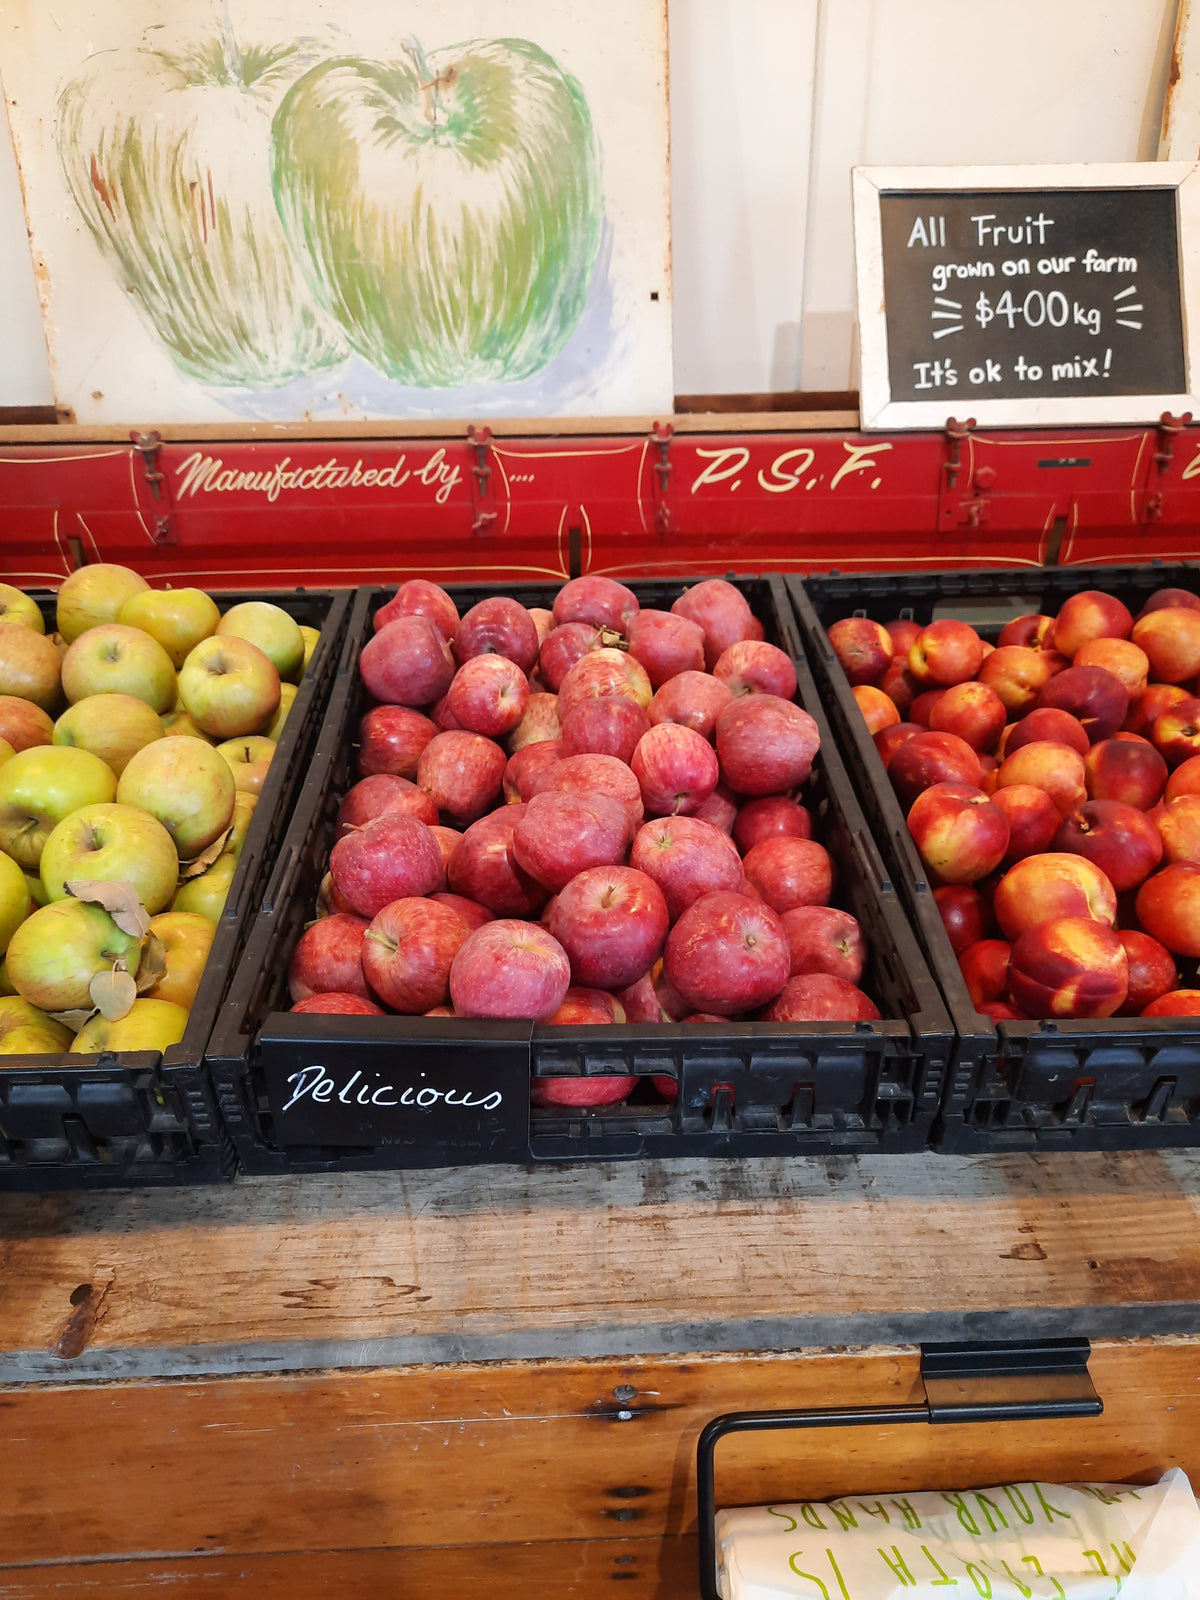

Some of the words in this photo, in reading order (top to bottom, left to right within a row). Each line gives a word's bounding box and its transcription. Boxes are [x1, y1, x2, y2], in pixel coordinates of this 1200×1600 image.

[906, 215, 946, 249] All
[970, 212, 1055, 247] Fruit
[931, 260, 996, 293] grown
[1001, 258, 1031, 277] on
[1036, 256, 1077, 275] our
[1081, 248, 1138, 274] farm
[912, 357, 959, 390] It's
[968, 358, 1003, 385] ok
[1013, 355, 1044, 381] to
[1051, 348, 1113, 382] mix!
[175, 451, 410, 502] Manufactured
[412, 447, 463, 503] by
[282, 1065, 503, 1111] Delicious
[767, 1498, 922, 1533] HANDS
[940, 1482, 1071, 1536] YOUR
